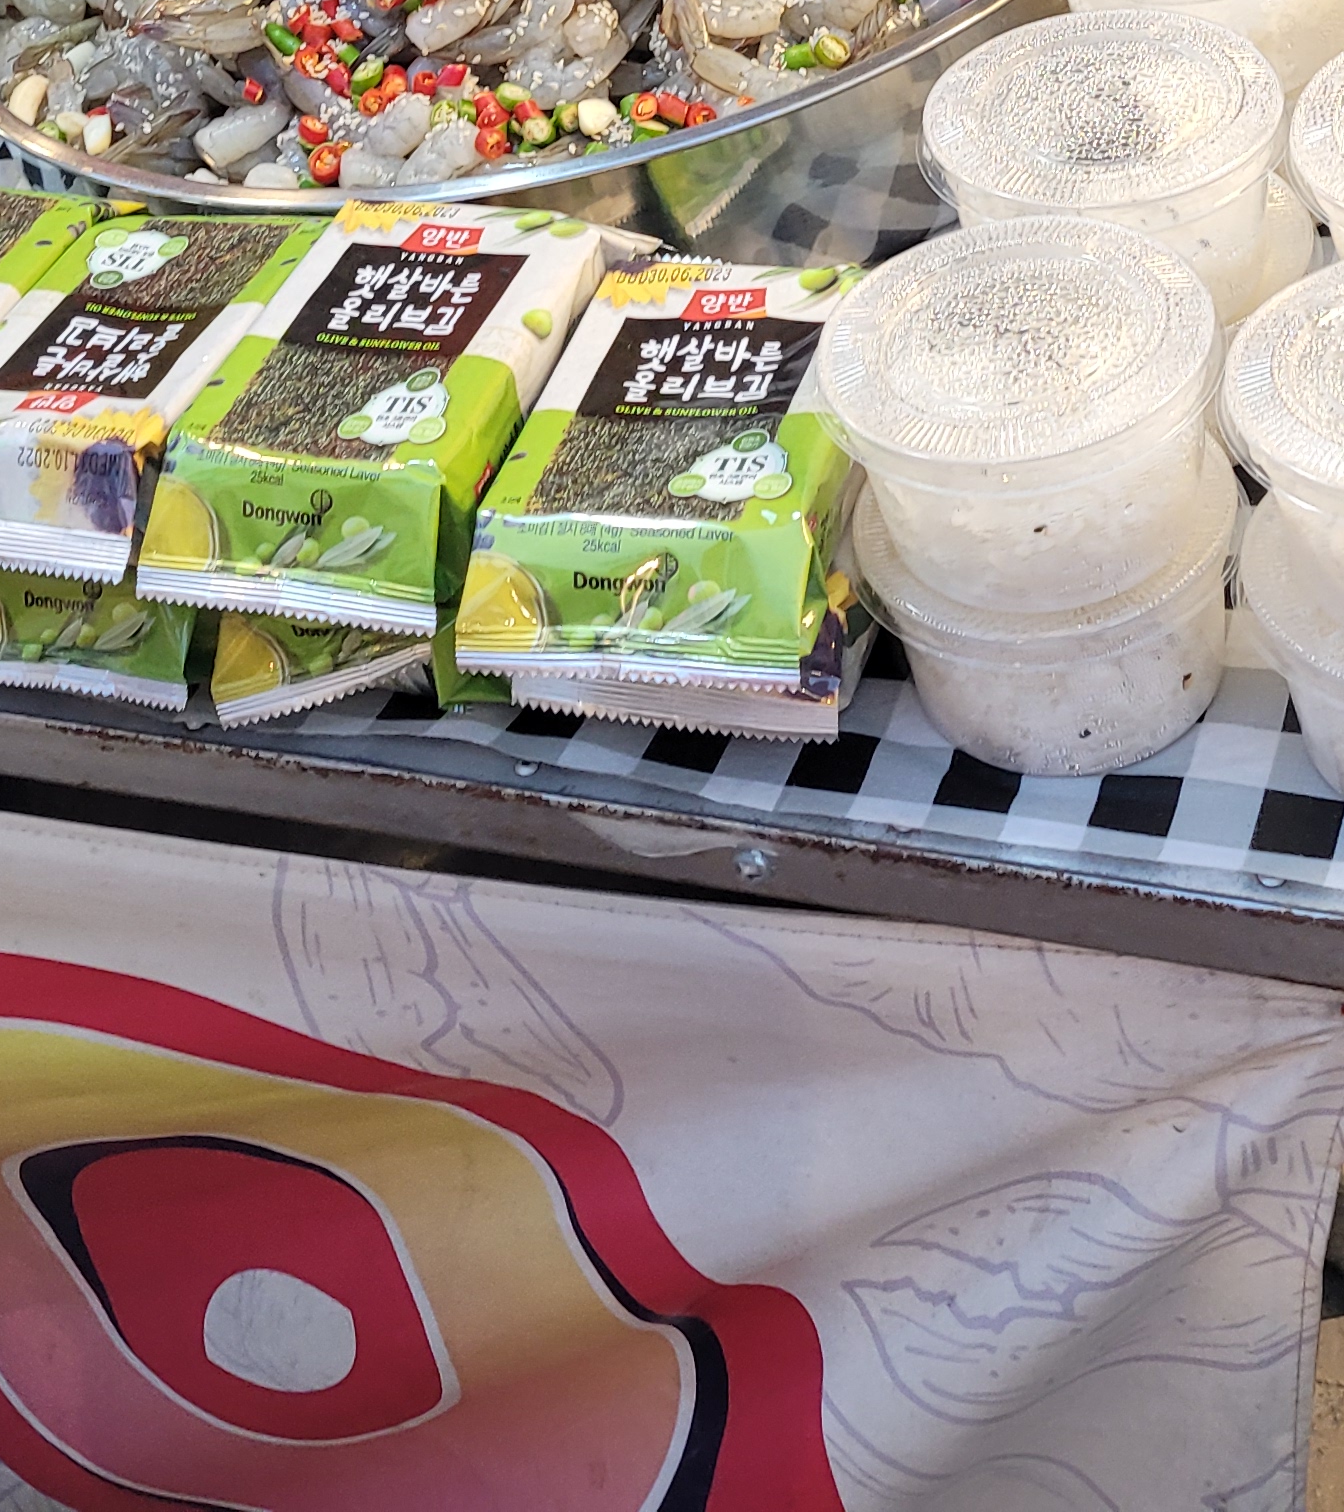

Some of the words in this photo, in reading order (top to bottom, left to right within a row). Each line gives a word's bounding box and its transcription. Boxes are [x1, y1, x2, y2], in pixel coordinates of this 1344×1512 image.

[421, 227, 470, 249] 양반
[101, 253, 146, 272] TIS
[400, 251, 465, 266] YANGBAN
[347, 262, 482, 305] 햇살바른
[700, 291, 754, 314] 양반
[326, 297, 466, 336] 올리브김
[683, 320, 755, 332] YANGBAN
[56, 315, 185, 353] 올리브김
[316, 332, 349, 346] OLIVE
[359, 338, 421, 351] SUNFLOWER
[422, 340, 441, 351] OIL
[637, 333, 784, 373] 햇살바른
[32, 346, 160, 385] 햇살바른
[622, 371, 774, 403] 올리브김
[29, 394, 78, 410] 양반
[386, 395, 433, 414] TIS
[614, 405, 651, 416] OLIVE
[663, 406, 737, 417] SUNFLOWER
[738, 405, 759, 416] OIL
[714, 454, 769, 473] TIS
[242, 499, 323, 527] Dongwon
[582, 539, 622, 554] 25kcal
[572, 570, 667, 597] Dongwon
[24, 589, 95, 614] Dongwon
